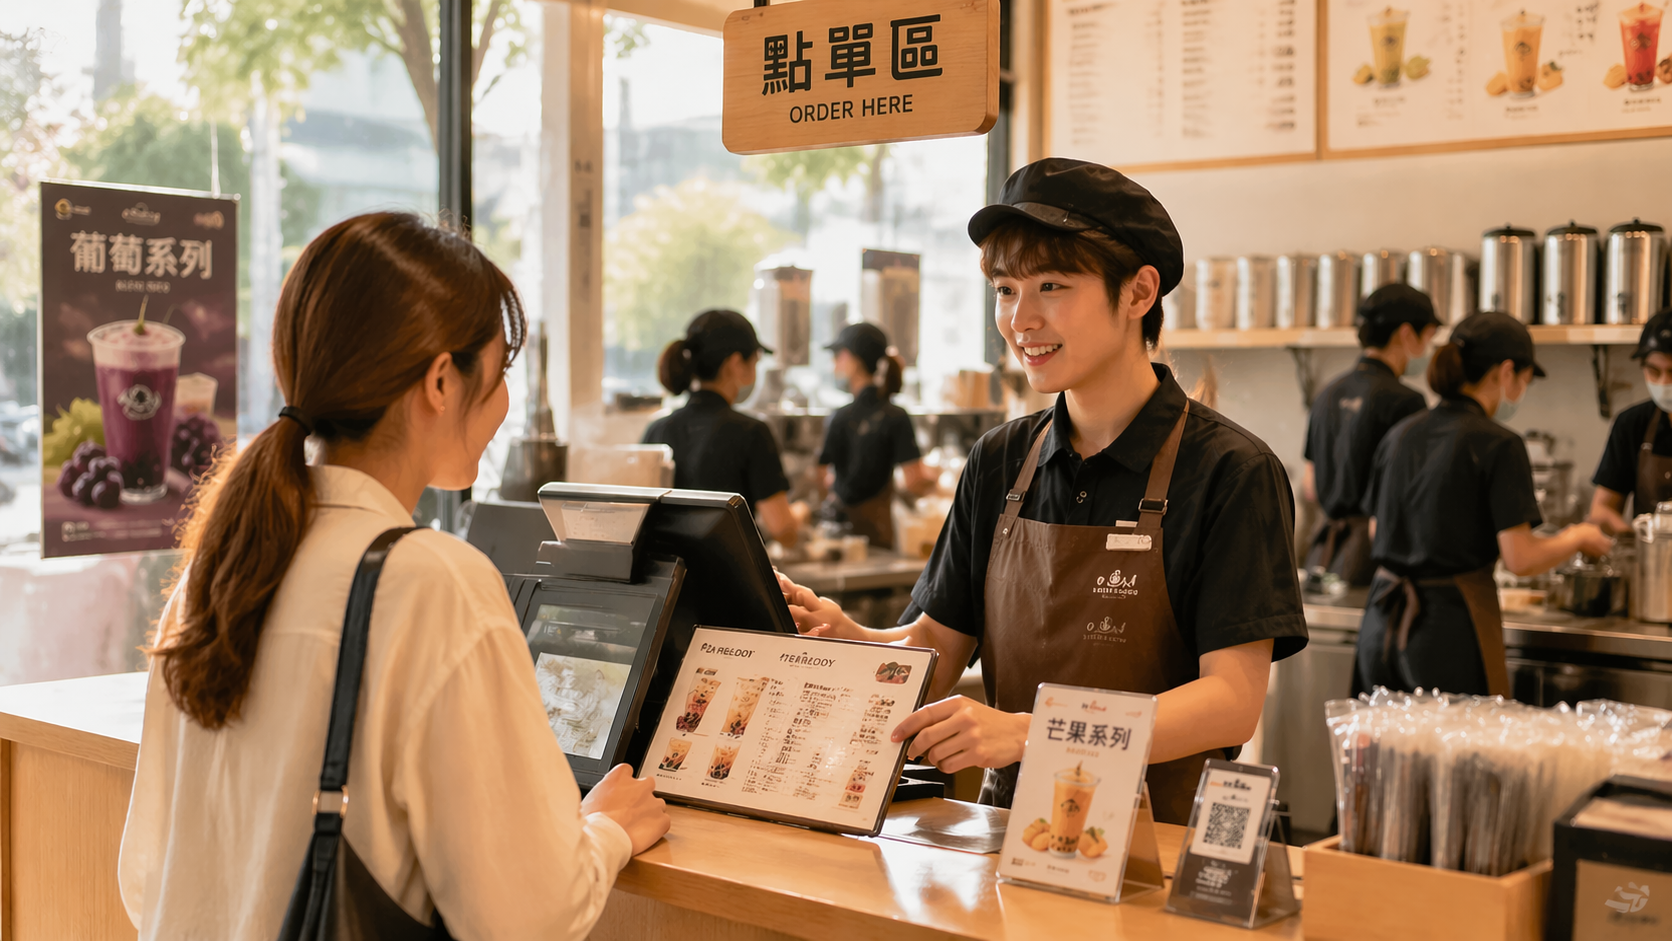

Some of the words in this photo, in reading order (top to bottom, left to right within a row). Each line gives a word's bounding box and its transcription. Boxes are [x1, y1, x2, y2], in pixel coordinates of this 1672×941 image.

[762, 14, 943, 96] 點單區
[790, 101, 854, 123] ORDER
[862, 94, 913, 117] HERE
[70, 230, 213, 280] 葡萄系列
[1047, 717, 1132, 751] 芒果系列
